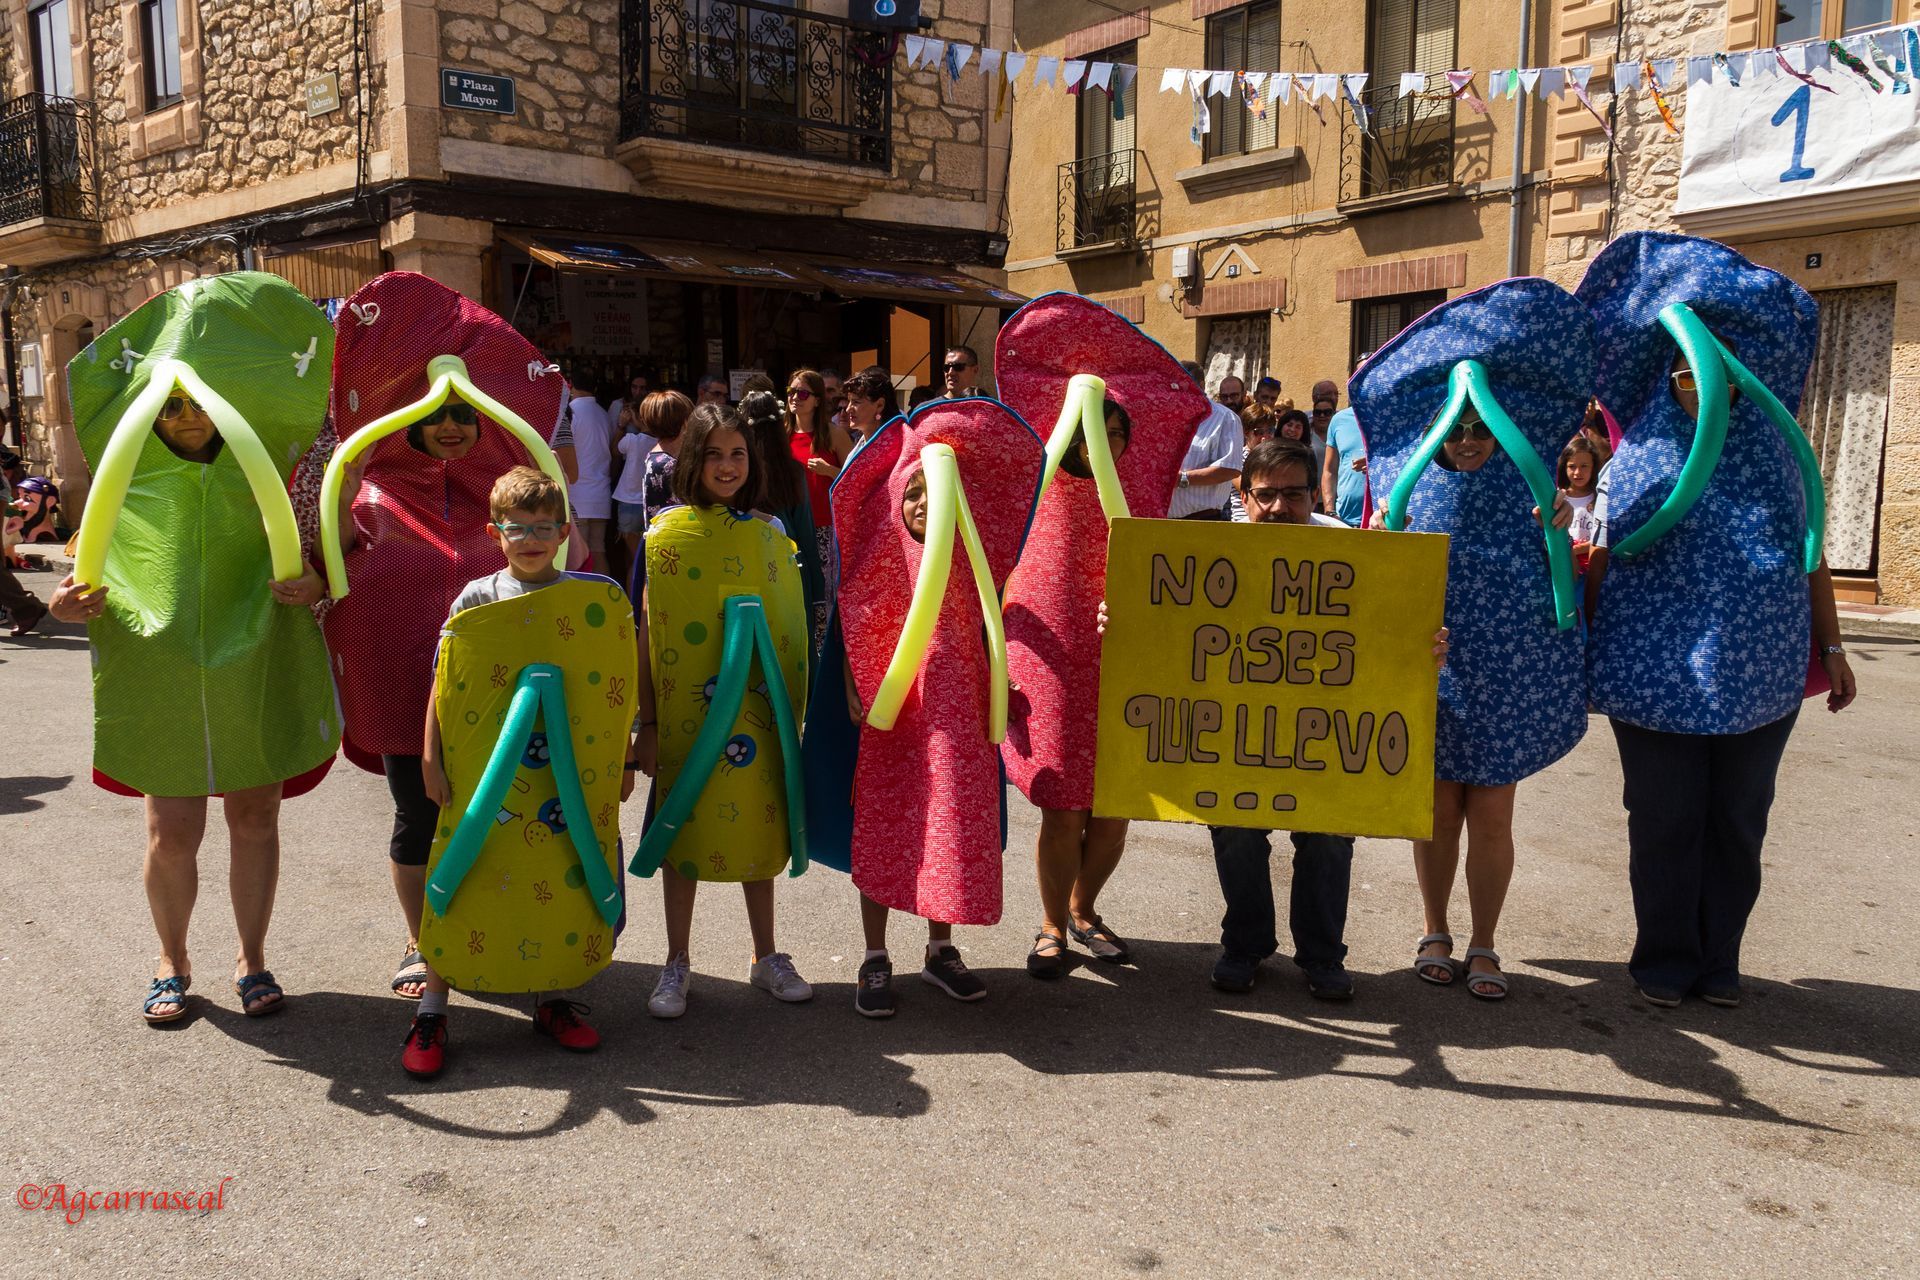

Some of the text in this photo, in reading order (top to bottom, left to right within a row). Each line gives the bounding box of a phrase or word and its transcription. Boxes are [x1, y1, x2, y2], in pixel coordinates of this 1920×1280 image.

[462, 79, 495, 92] Plaza
[460, 92, 498, 106] Mayor
[1771, 84, 1815, 183] 1
[1809, 256, 1817, 266] 2
[1229, 266, 1235, 274] 3
[593, 312, 631, 322] VERANO
[592, 325, 633, 335] CULTURAL
[1150, 553, 1237, 608] NO
